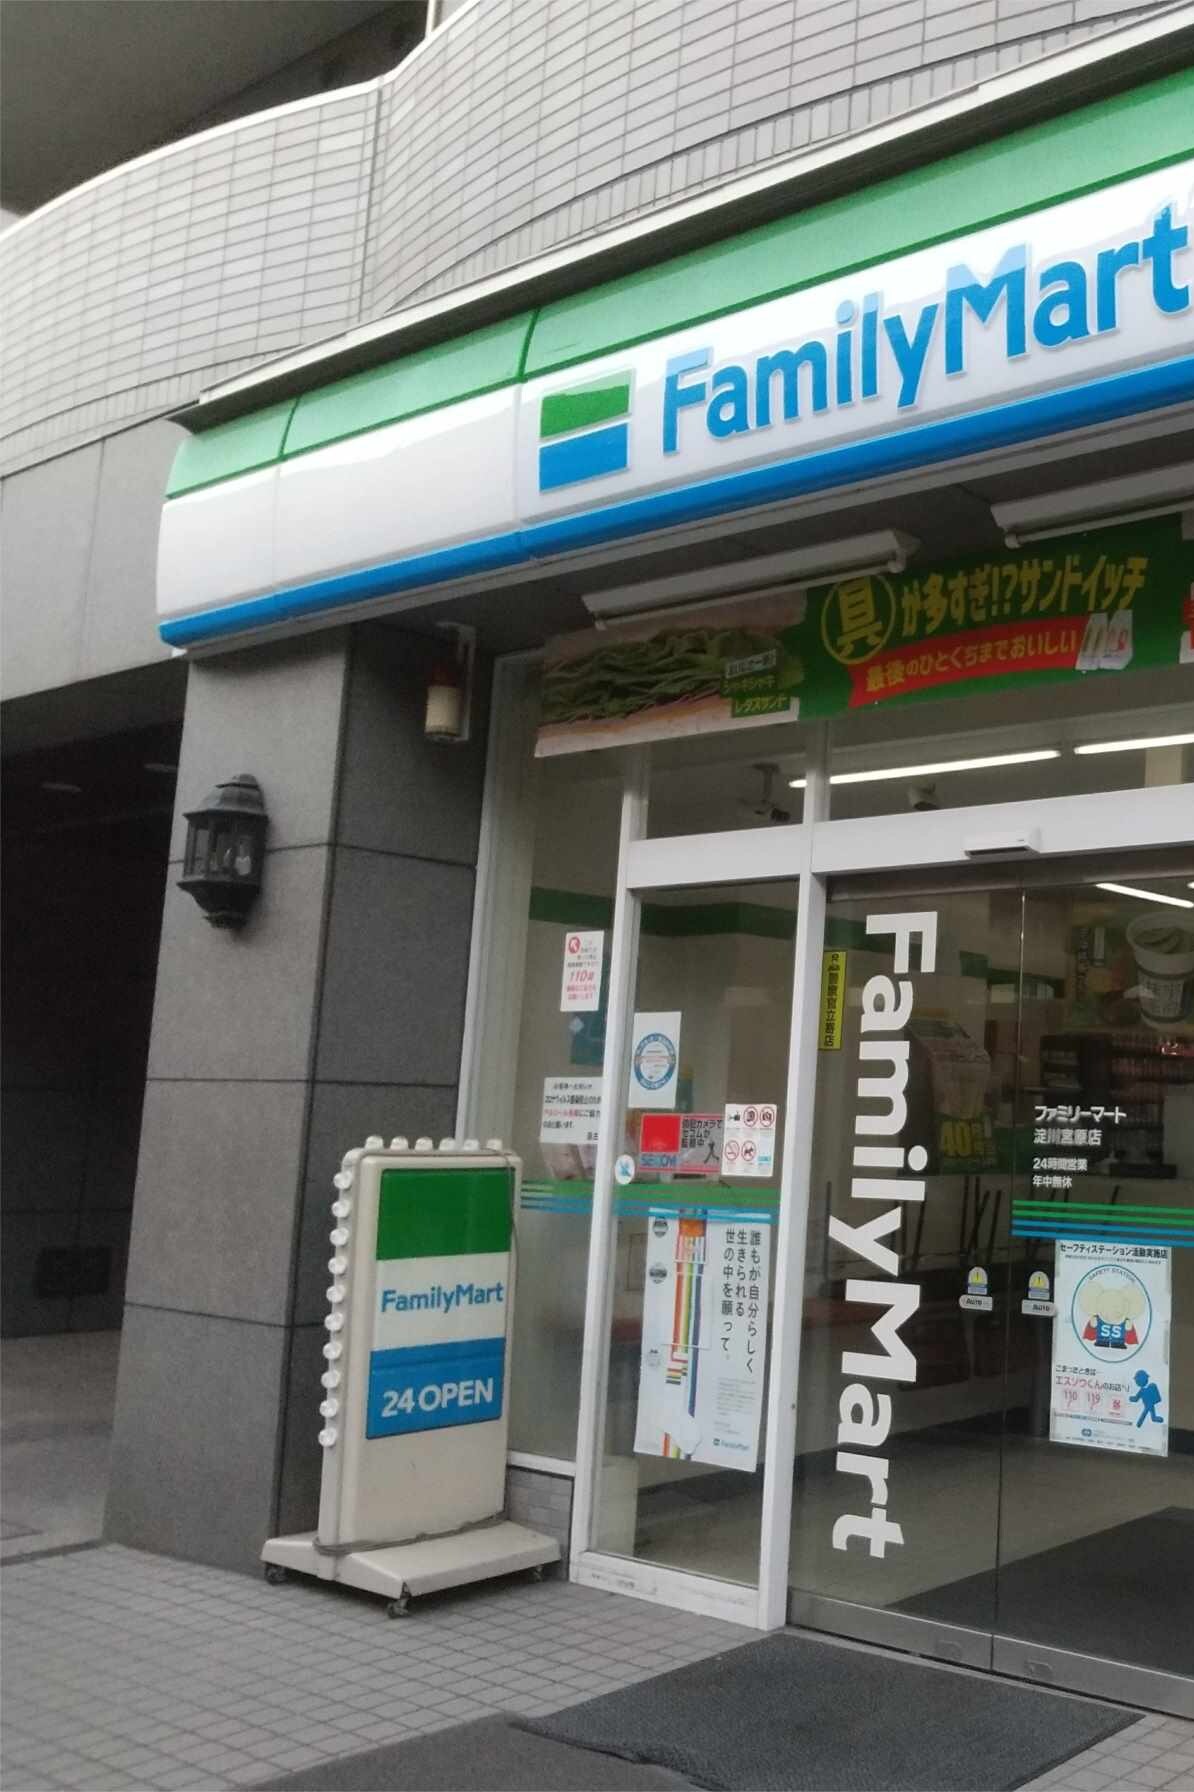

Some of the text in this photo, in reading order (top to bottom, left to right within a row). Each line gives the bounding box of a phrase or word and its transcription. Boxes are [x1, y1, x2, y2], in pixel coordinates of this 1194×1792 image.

[662, 203, 1192, 455] FamilyMart
[866, 631, 1077, 692] 最後のひとくちまでおいしい
[1034, 1105, 1127, 1124] ファミリーマート
[1032, 1157, 1087, 1171] 24時間営業
[1032, 1175, 1072, 1188] 年中無休
[828, 911, 937, 1559] FamilyMart
[735, 1231, 748, 1317] 生きられる
[381, 1282, 504, 1315] FamilyMart
[746, 1231, 761, 1374] 誰もが自分らしく
[1101, 1325, 1122, 1338] SS
[381, 1378, 493, 1418] 24 OPEN
